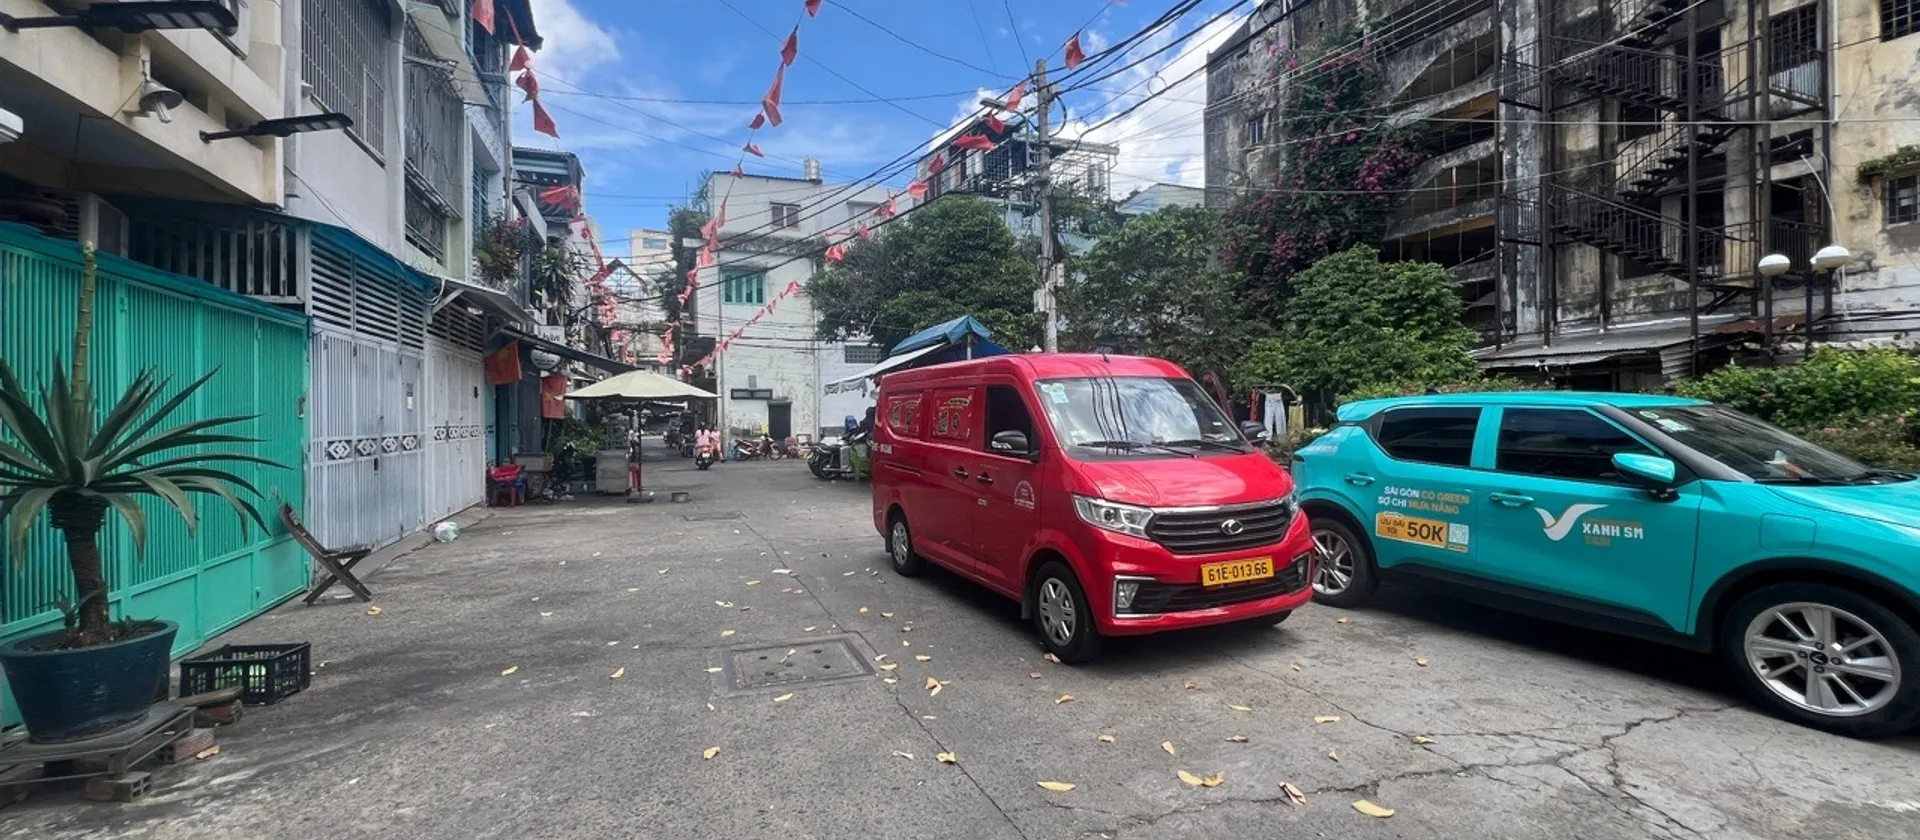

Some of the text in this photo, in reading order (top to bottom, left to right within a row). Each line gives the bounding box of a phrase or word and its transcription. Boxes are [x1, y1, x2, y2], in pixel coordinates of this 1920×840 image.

[1391, 498, 1407, 507] CHI
[1407, 521, 1443, 542] 50K
[1582, 522, 1644, 539] XANH SM
[1208, 562, 1268, 582] 61E-013.66
